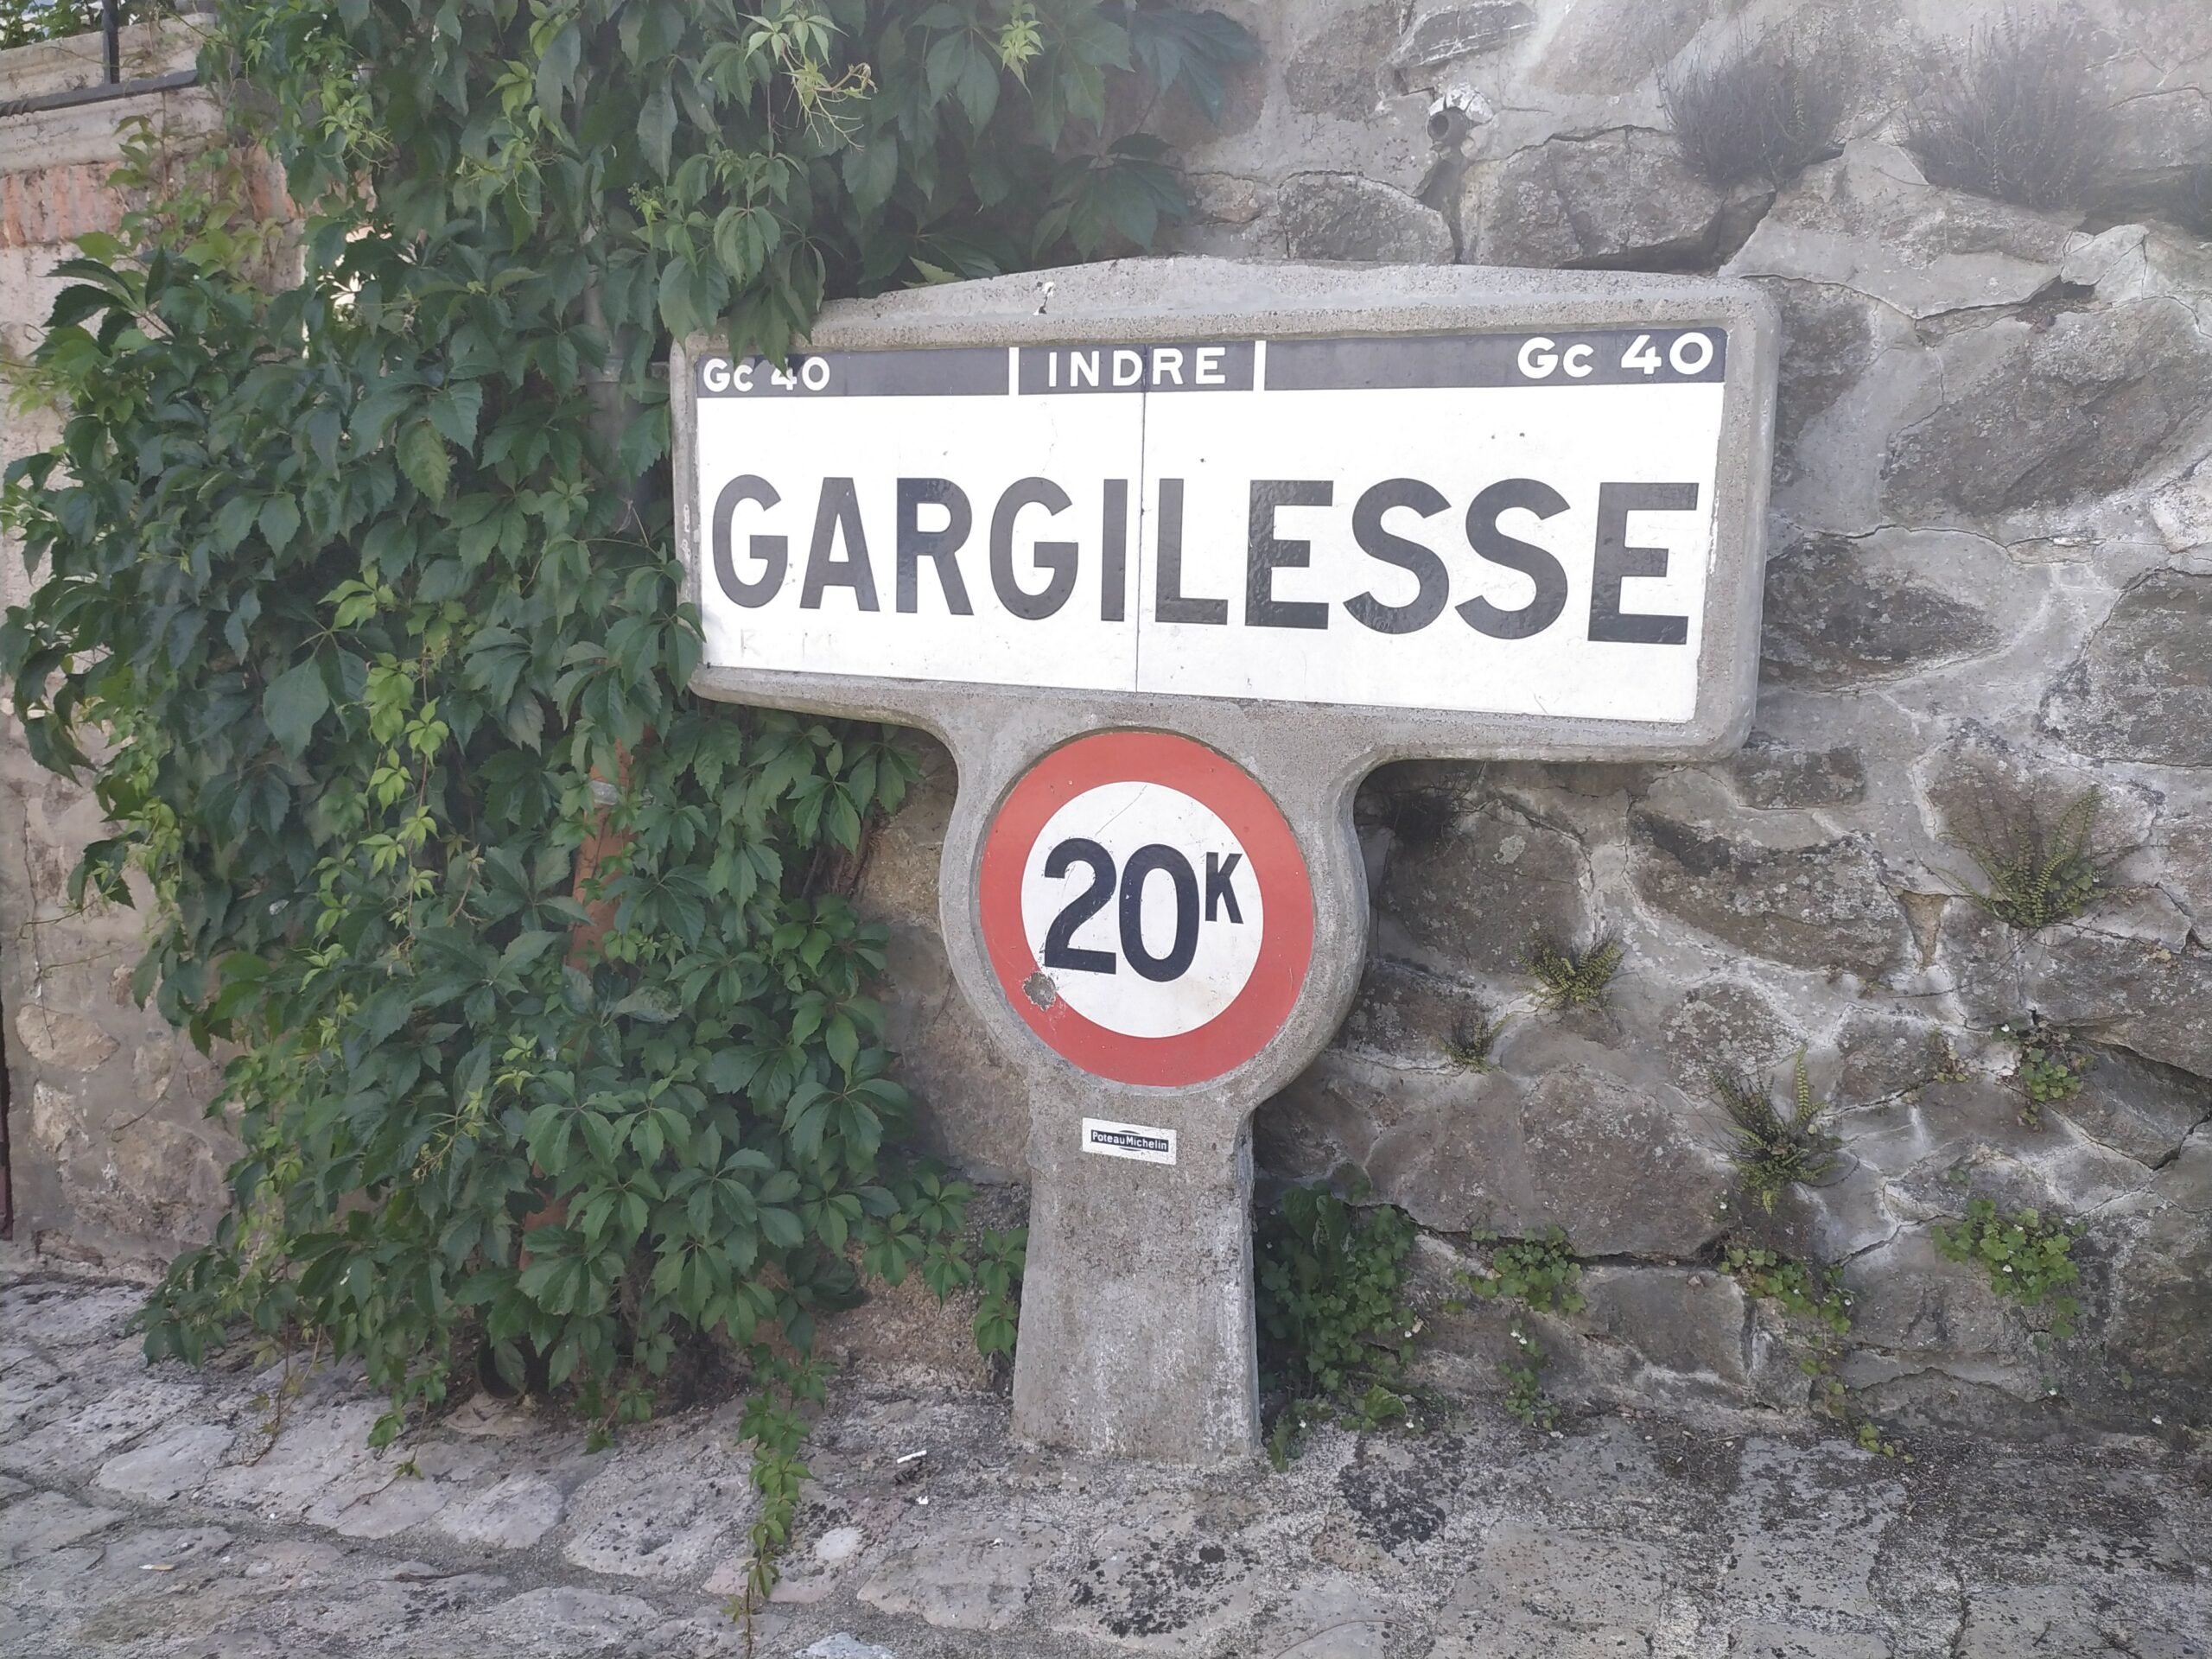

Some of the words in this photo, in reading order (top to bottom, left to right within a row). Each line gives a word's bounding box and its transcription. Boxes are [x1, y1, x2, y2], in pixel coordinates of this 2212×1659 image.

[1048, 347, 1226, 388] INDRE
[1517, 336, 1594, 379] Gc
[1621, 332, 1713, 375] 40
[711, 474, 1699, 645] GARGILESSE
